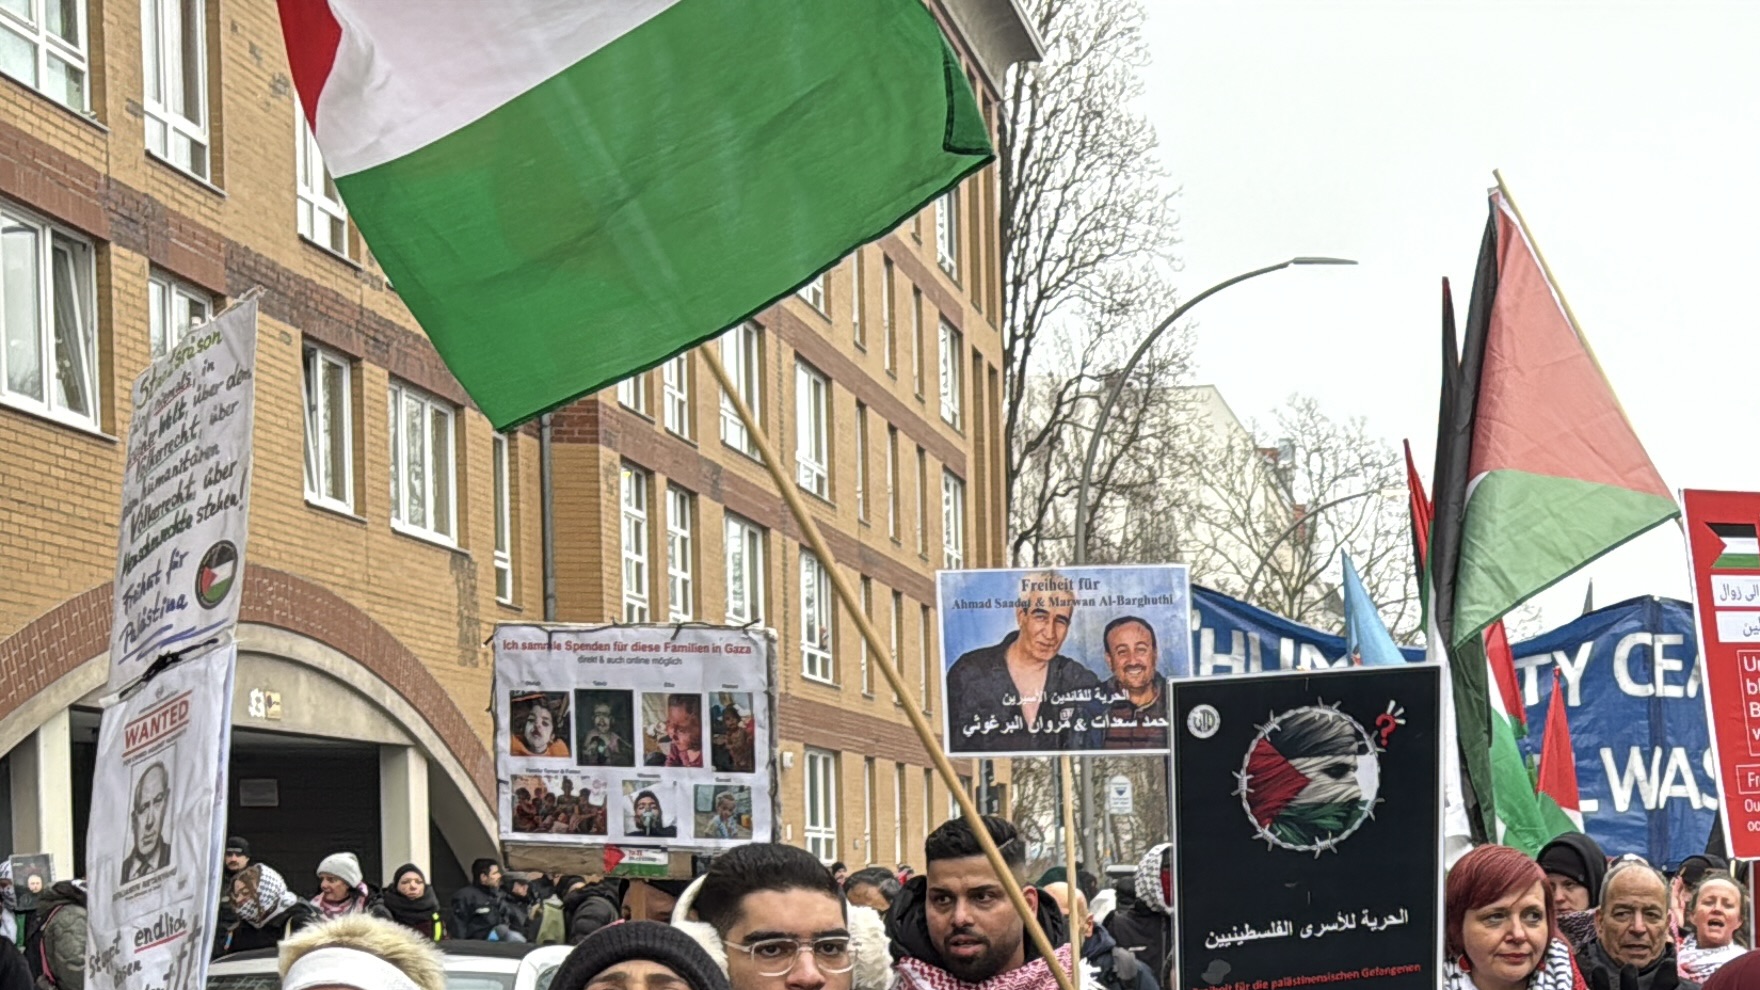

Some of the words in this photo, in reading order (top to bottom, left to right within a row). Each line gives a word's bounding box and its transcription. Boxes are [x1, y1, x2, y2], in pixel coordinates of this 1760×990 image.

[1022, 578, 1074, 592] Freiheit
[1079, 578, 1100, 590] für
[1720, 584, 1741, 601] زوال
[952, 598, 992, 610] Ahmad
[1035, 597, 1044, 608] &
[1050, 597, 1095, 608] Marwan
[1100, 594, 1174, 608] Al-Barghuthi
[503, 640, 518, 651] Ich
[565, 641, 611, 653] Spenden
[613, 641, 629, 652] für
[632, 641, 661, 653] diese
[664, 642, 710, 653] Familien
[712, 643, 721, 654] in
[724, 643, 752, 655] Gaza
[1514, 641, 1594, 707] TY
[1094, 688, 1129, 706] الحرية
[125, 700, 189, 749] WANTED
[1074, 718, 1087, 731] &
[1300, 911, 1357, 940] للأسرى
[1361, 909, 1408, 932] الحرية
[1204, 919, 1293, 950] الفلسطينيين
[1271, 971, 1359, 990] palästinensischen
[1362, 963, 1421, 979] Gefangenen
